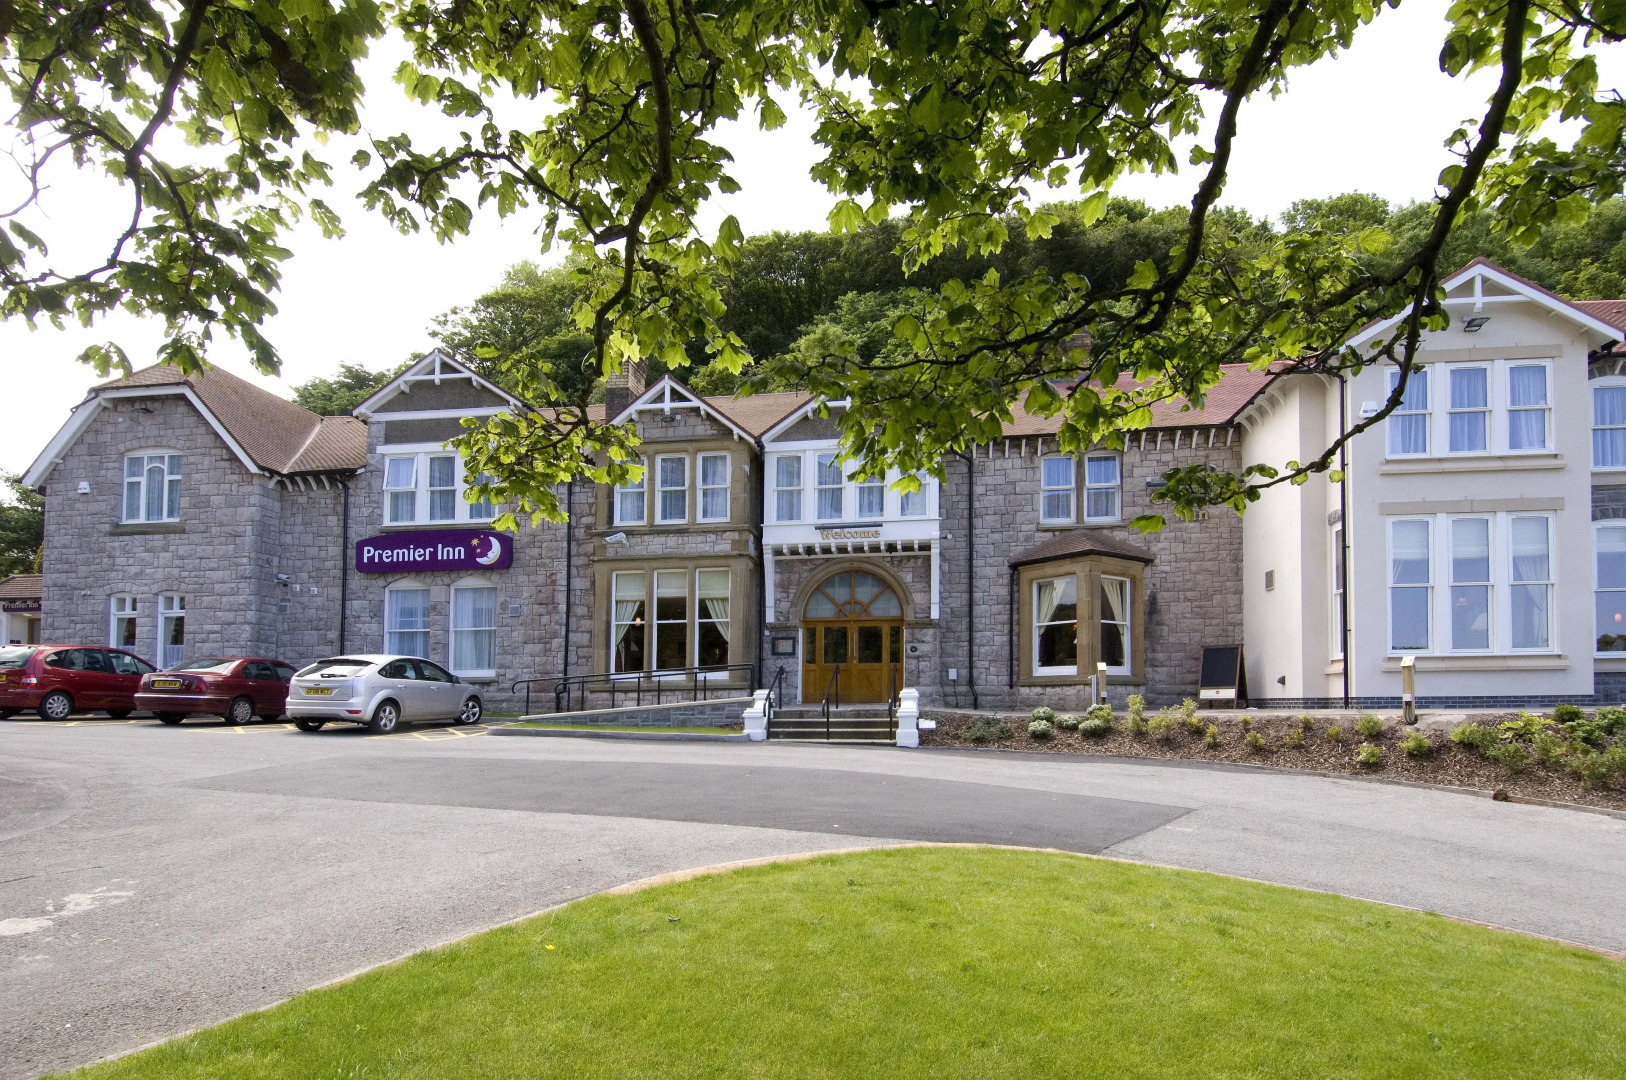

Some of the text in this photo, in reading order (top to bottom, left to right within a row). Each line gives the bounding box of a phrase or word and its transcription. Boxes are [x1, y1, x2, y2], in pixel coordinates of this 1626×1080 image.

[819, 528, 881, 540] Welcome
[363, 543, 465, 563] Premier Inn
